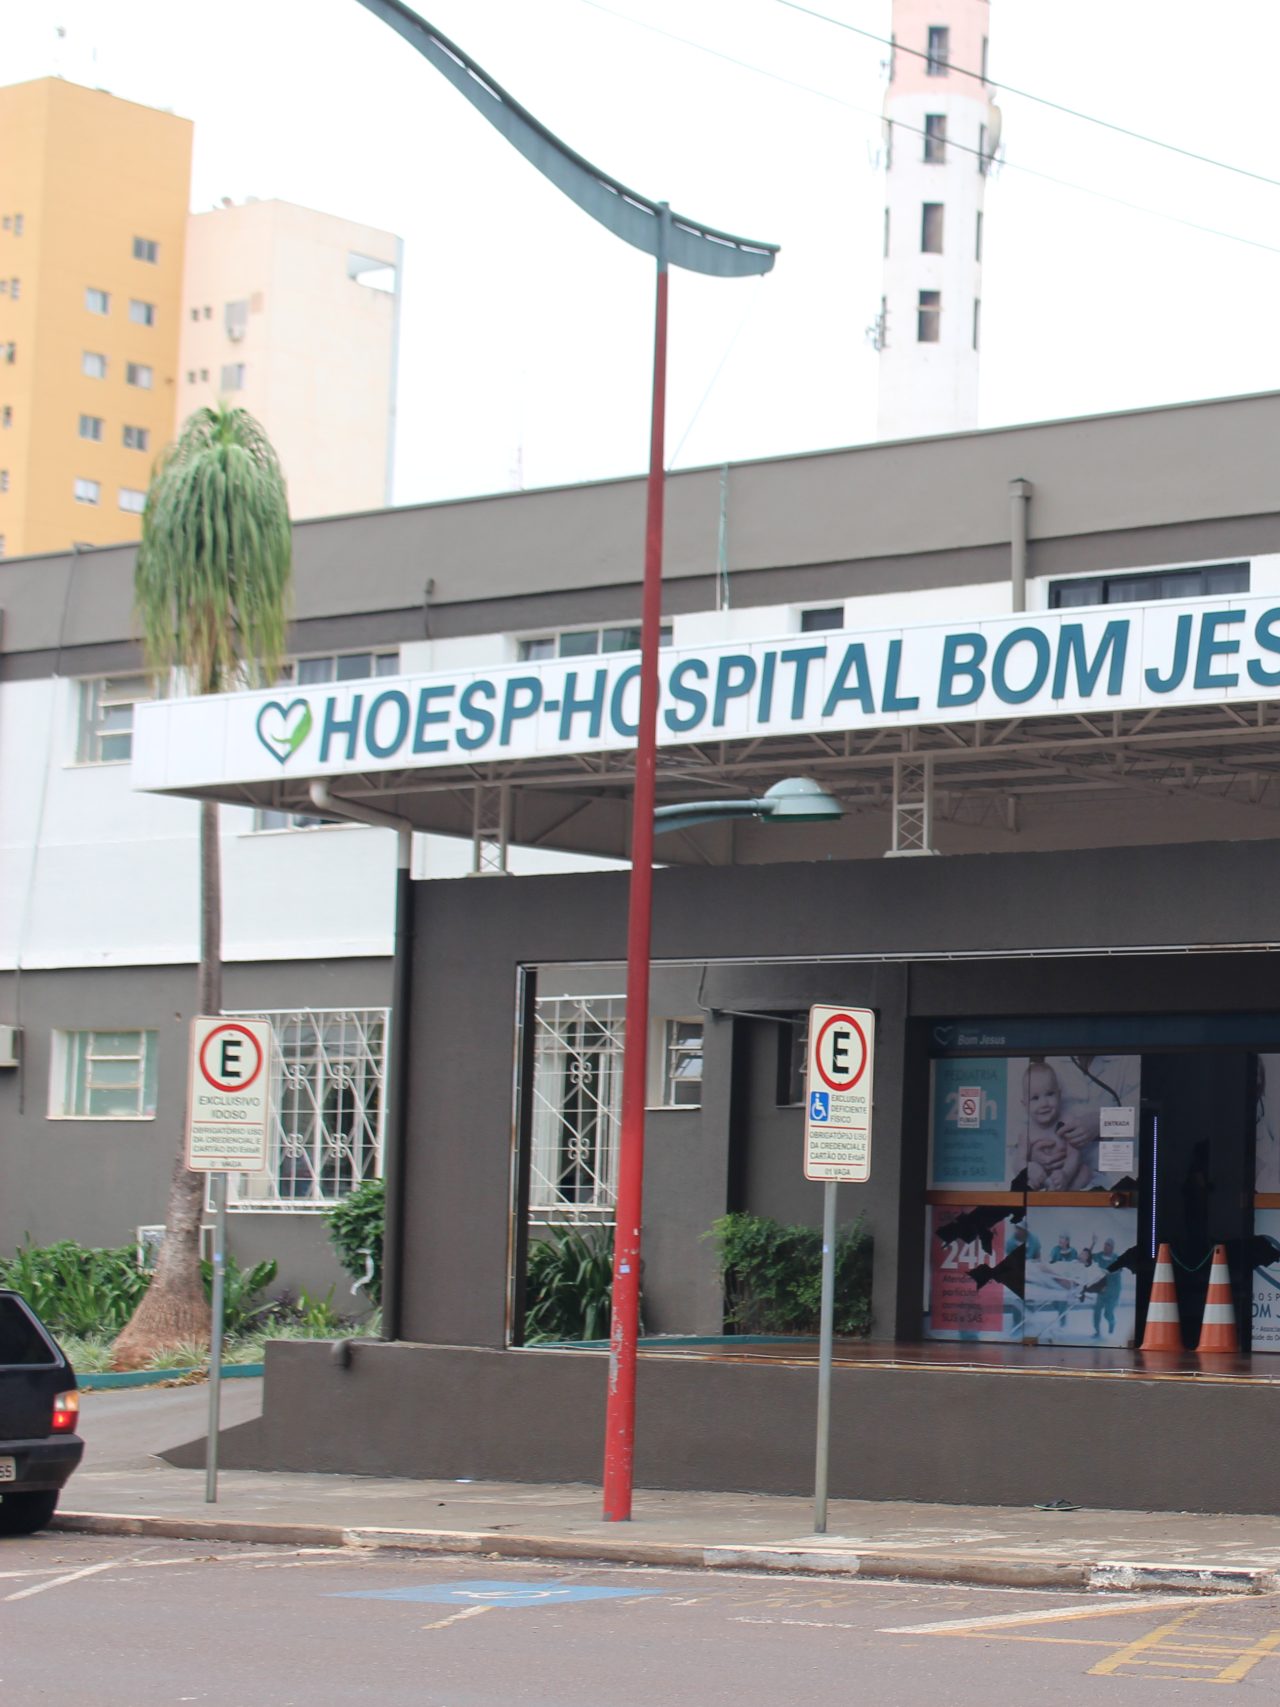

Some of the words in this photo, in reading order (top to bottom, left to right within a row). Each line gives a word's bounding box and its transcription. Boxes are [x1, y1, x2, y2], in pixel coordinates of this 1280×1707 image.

[936, 618, 1131, 710] BOM
[957, 1034, 978, 1046] Bom
[979, 1034, 1007, 1046] Jesus
[220, 1039, 244, 1078] E
[831, 1030, 851, 1075] E
[199, 1095, 261, 1107] EXCLUSIVO
[831, 1094, 866, 1104] EXCLUSIVO
[830, 1104, 867, 1115] DEFICIENTE
[944, 1090, 999, 1121] 2h
[211, 1109, 248, 1120] IDOSO
[809, 1141, 819, 1149] DA
[820, 1142, 862, 1151] CREDENCIAL
[837, 1152, 847, 1161] DO
[1252, 1302, 1272, 1318] OM
